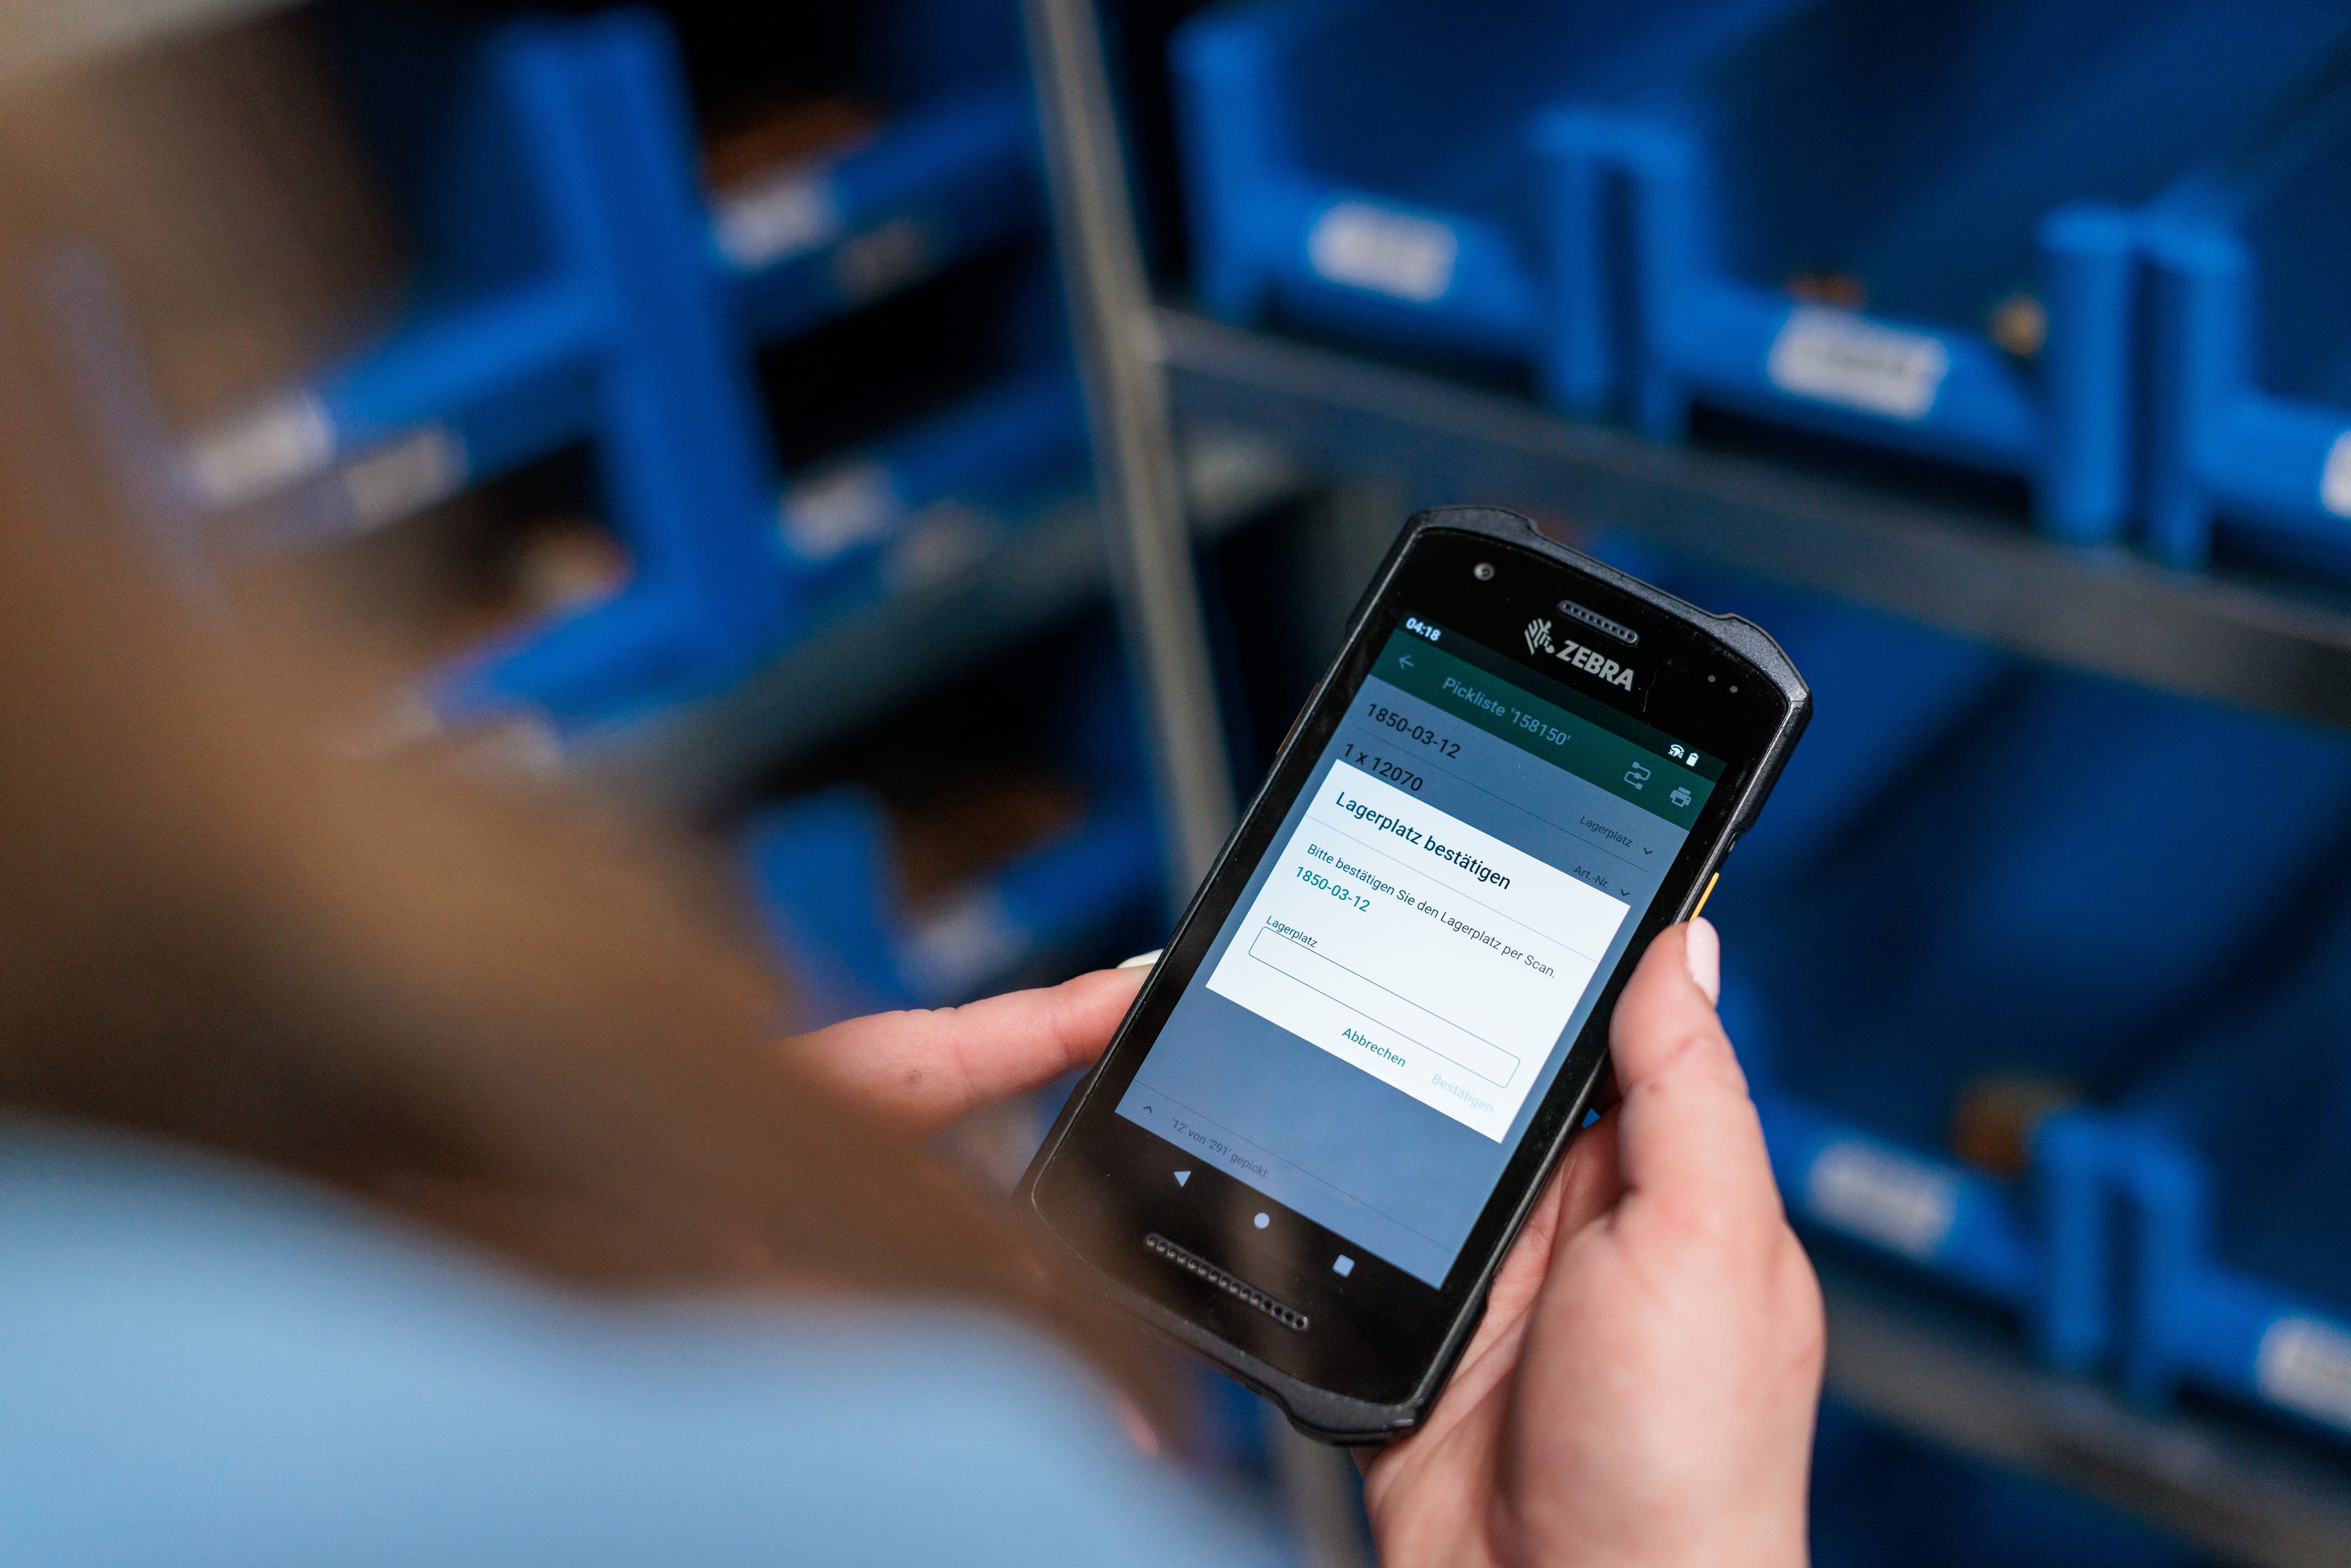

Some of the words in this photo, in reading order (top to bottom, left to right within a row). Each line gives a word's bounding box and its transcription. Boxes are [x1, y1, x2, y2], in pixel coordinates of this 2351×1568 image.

[1406, 617, 1441, 641] 04:18
[1556, 640, 1633, 691] ZEBRA
[1368, 704, 1460, 759] 1850-03-12
[1442, 677, 1505, 716] Pickliste
[1511, 708, 1570, 745] '158150'
[1344, 744, 1354, 757] 1
[1355, 752, 1368, 765] x
[1372, 757, 1423, 791] 12070
[1336, 792, 1422, 844] Lagerplatz
[1424, 836, 1510, 889] bestätigen
[1580, 815, 1633, 847] Lagerplatz
[1296, 866, 1370, 912] 1850-03-12
[1573, 866, 1608, 888] Art.-Nr.
[1266, 915, 1318, 948] Lagerplatz
[1307, 844, 1333, 863] Bitte
[1335, 858, 1395, 895] bestätigen
[1397, 890, 1415, 906] Sie
[1417, 901, 1438, 918] den
[1440, 912, 1501, 950] Lagerplatz
[1501, 945, 1523, 960] per
[1524, 955, 1554, 978] Scan.
[1342, 1028, 1406, 1067] Abbrechen
[1431, 1073, 1493, 1113] Bestätigen
[1188, 1130, 1206, 1145] von
[1229, 1153, 1268, 1177] gepickt
